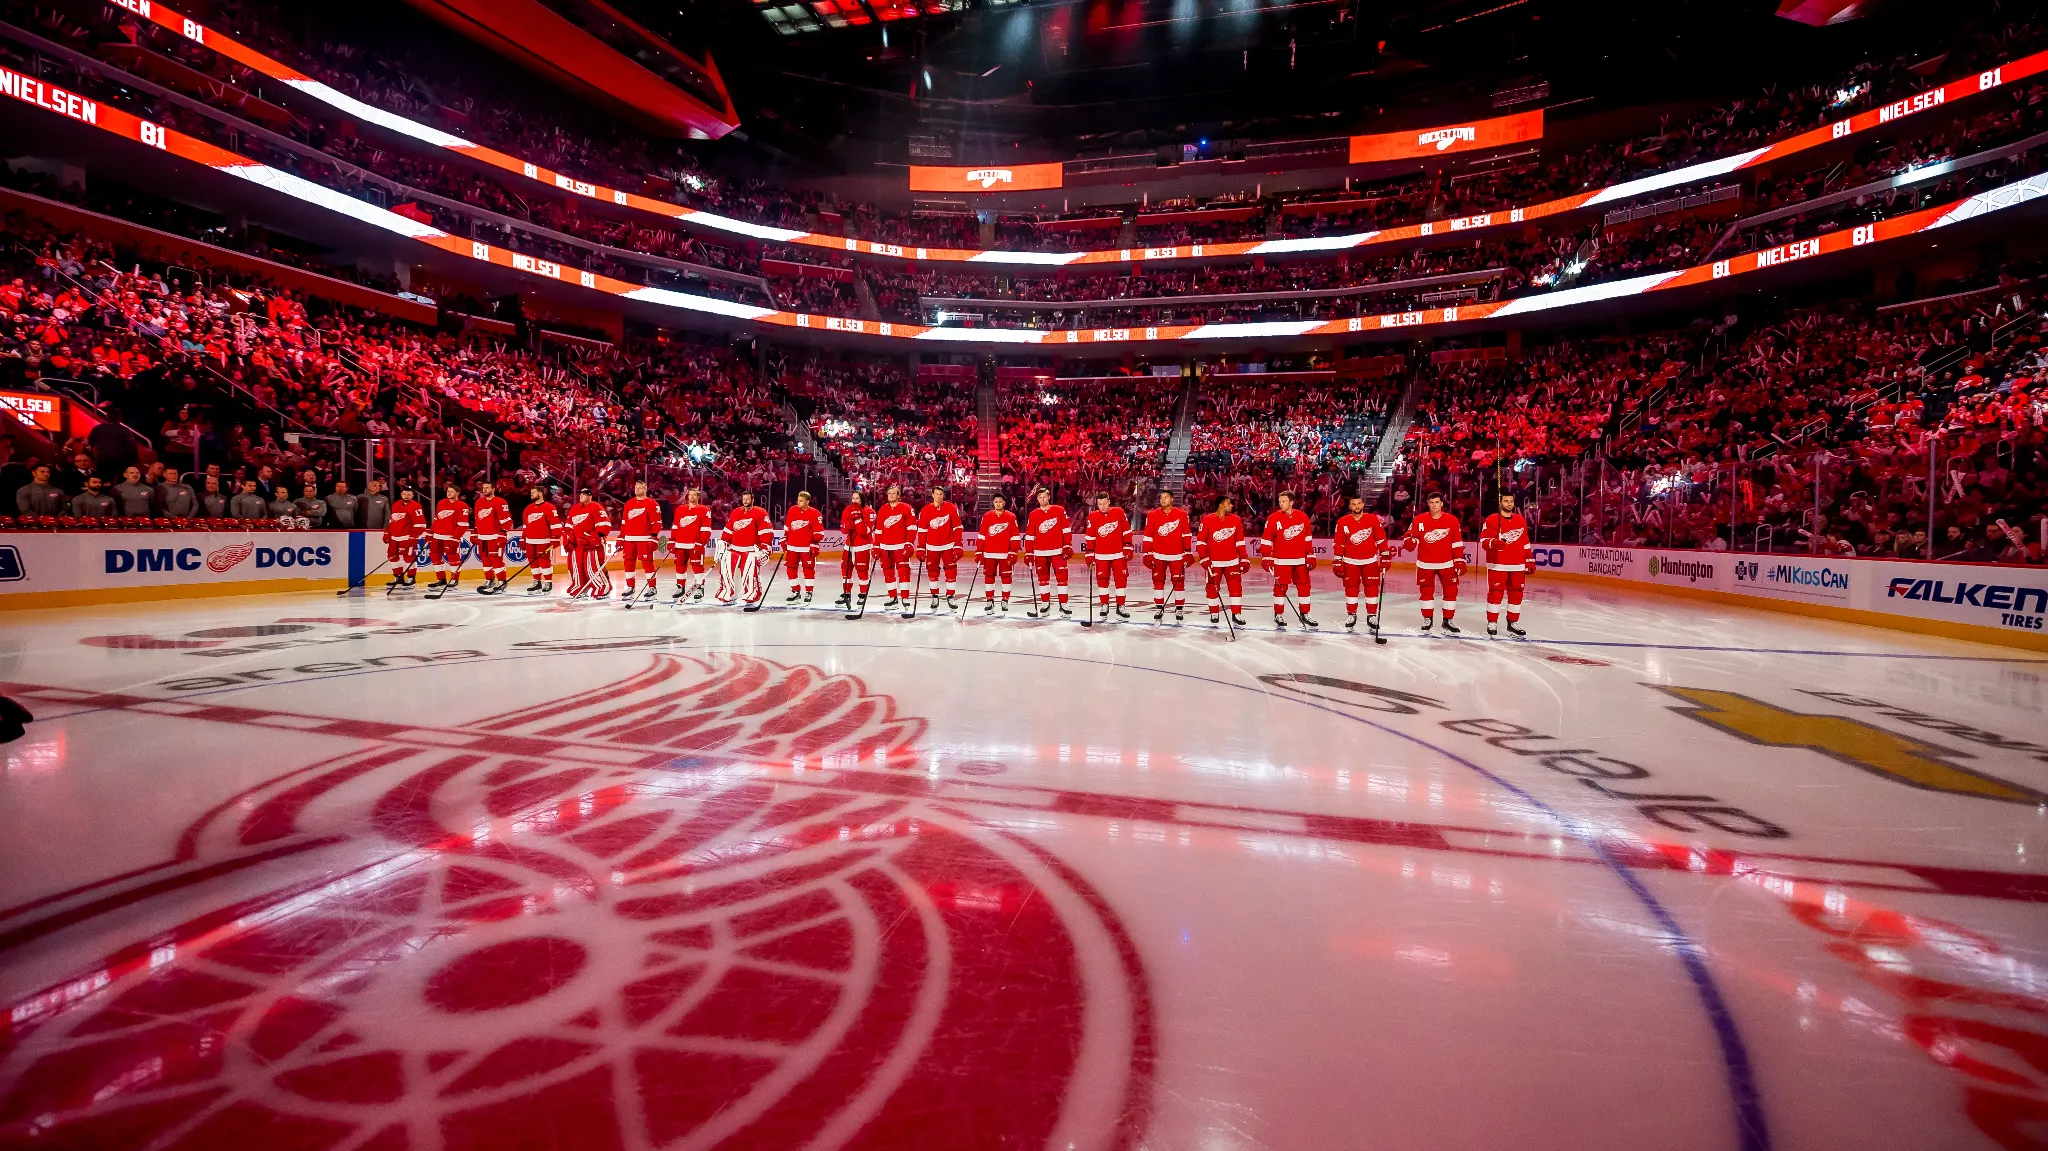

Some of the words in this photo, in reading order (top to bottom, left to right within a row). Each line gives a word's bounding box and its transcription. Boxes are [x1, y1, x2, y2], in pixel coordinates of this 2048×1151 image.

[183, 18, 204, 44] 81
[0, 68, 97, 124] NIELSEN
[140, 120, 166, 150] 81
[1832, 119, 1851, 139] 81
[1879, 87, 1945, 123] NIELSEN
[1979, 67, 2002, 90] 81
[556, 174, 596, 198] NIELSEN
[1420, 223, 1433, 236] 81
[1450, 214, 1491, 232] NIELSEN
[1510, 208, 1524, 222] 81
[1712, 260, 1730, 280] 81
[1757, 238, 1820, 268] NIELSEN
[1852, 224, 1875, 246] 81
[472, 242, 490, 262] 81
[512, 253, 560, 278] NIELSEN
[581, 271, 595, 289] 81
[826, 316, 864, 332] NIELSEN
[1349, 318, 1362, 332] 81
[1380, 312, 1423, 328] NIELSEN
[1444, 308, 1458, 322] 81
[1094, 328, 1130, 341] NIELSEN
[0, 396, 52, 413] NIELSEN
[1276, 520, 1283, 530] A
[1344, 526, 1350, 534] A
[1418, 522, 1424, 532] A
[104, 548, 202, 574] DMC
[256, 546, 331, 568] DOCS
[1579, 548, 1634, 562] INTERNATIONAL
[1660, 556, 1714, 582] Huntington
[1885, 577, 2048, 614] FALKEN
[2001, 612, 2043, 630] TIRES
[154, 649, 490, 691] arena
[1439, 719, 1791, 840] arena
